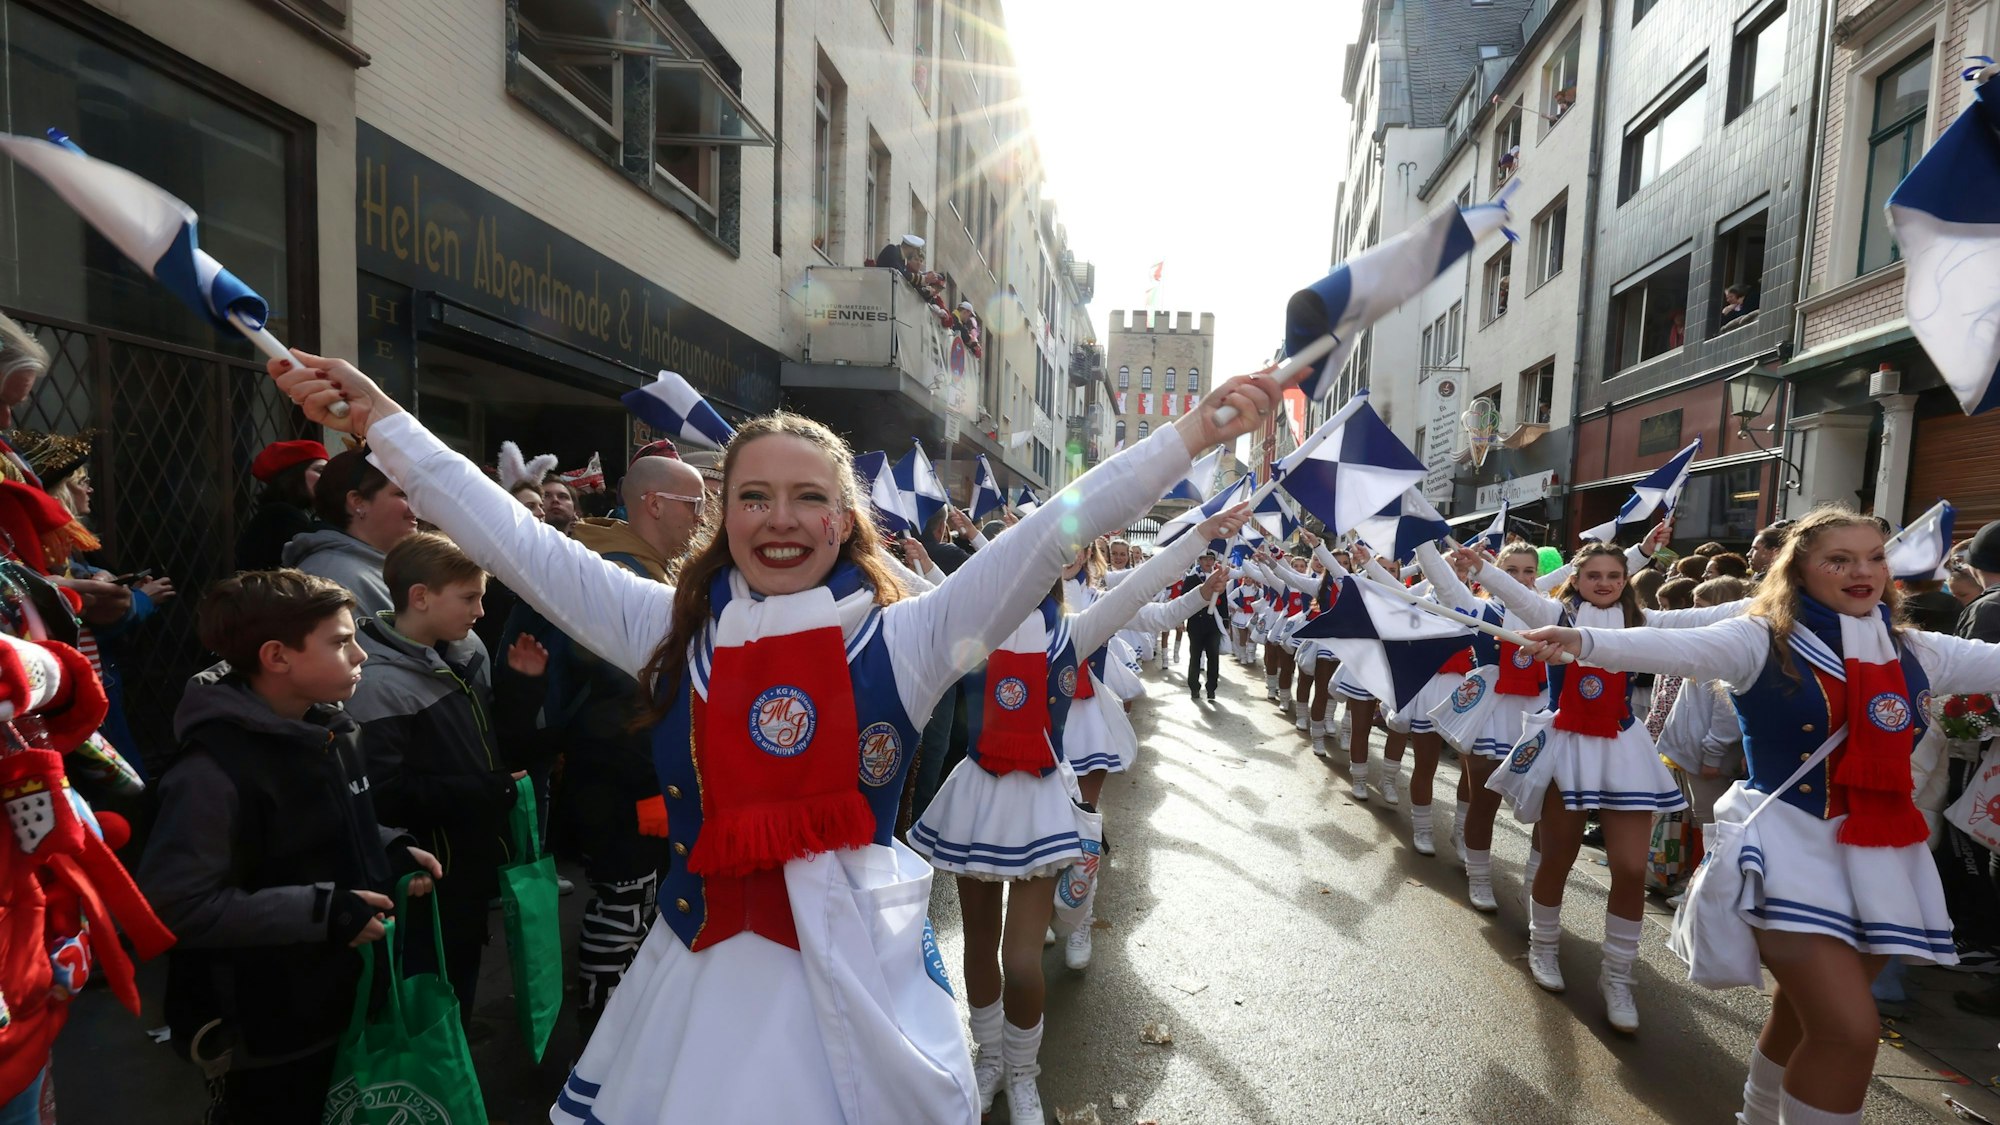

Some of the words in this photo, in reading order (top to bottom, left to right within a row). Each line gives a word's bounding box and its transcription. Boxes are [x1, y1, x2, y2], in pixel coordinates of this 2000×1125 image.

[362, 156, 461, 281] Helen
[473, 215, 611, 342] Abendmode
[618, 287, 632, 352] &
[814, 309, 888, 322] HENNES
[776, 687, 788, 695] KG
[753, 694, 768, 710] 1951
[402, 1091, 438, 1121] 1922
